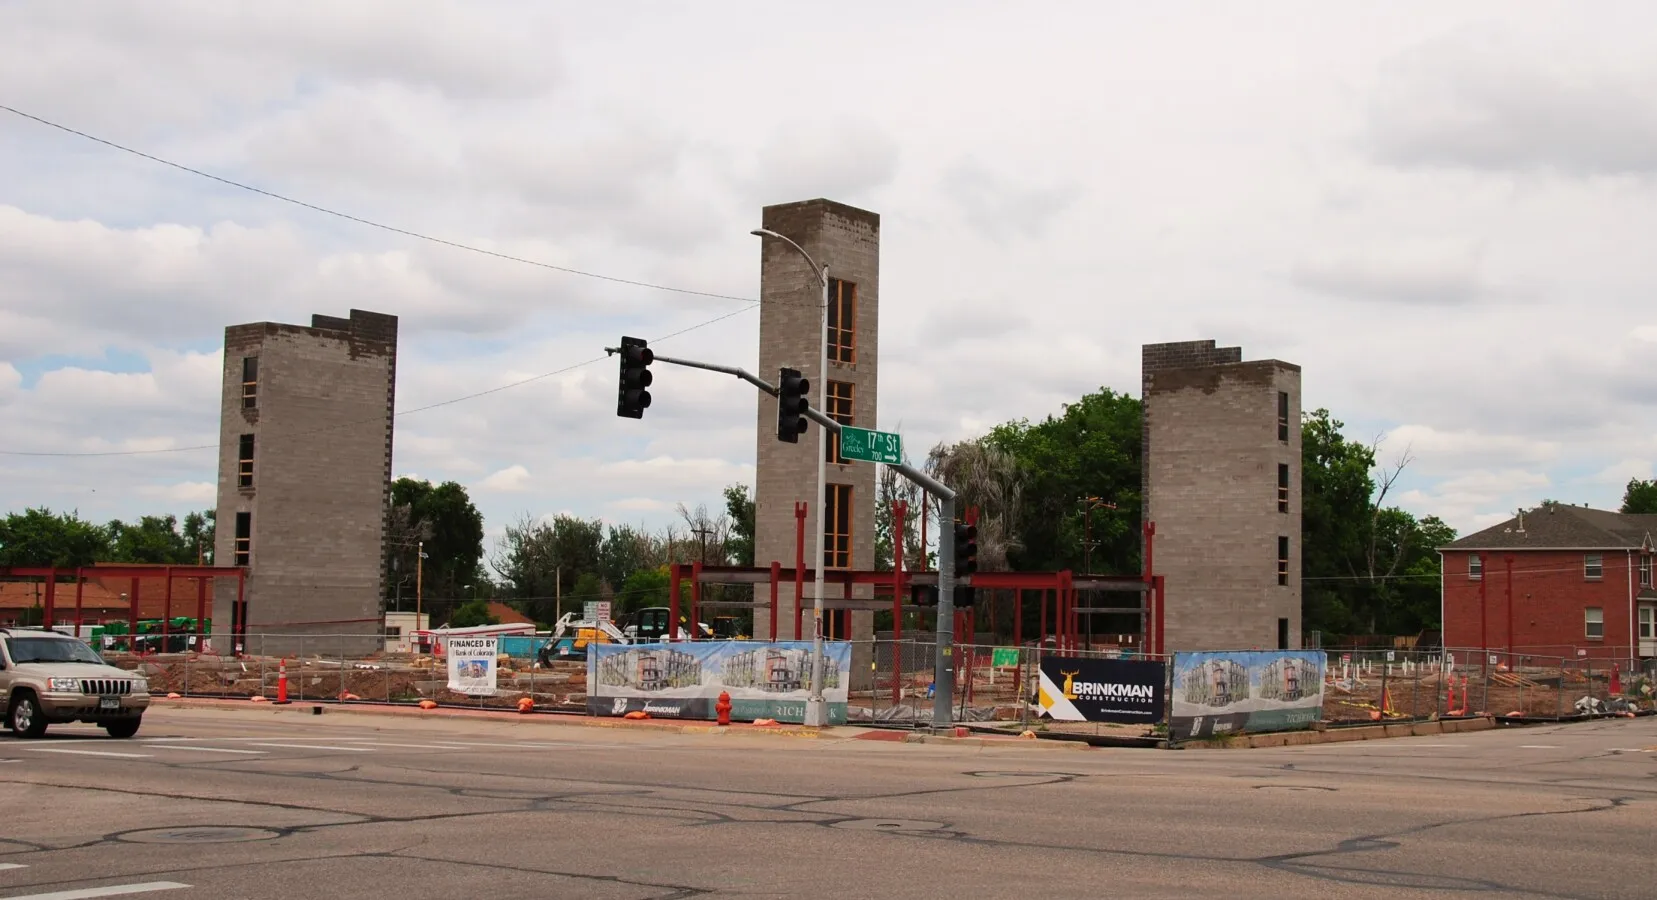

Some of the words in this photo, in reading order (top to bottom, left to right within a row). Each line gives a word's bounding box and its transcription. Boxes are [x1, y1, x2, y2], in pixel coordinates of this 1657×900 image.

[868, 432, 883, 449] 17th
[886, 434, 897, 452] St
[871, 451, 882, 461] 700
[449, 640, 484, 648] FINANCED
[486, 640, 496, 648] BY
[1072, 682, 1153, 697] BRINKMAN
[1079, 695, 1153, 703] CONSTRUCTION
[776, 706, 837, 718] RICHK
